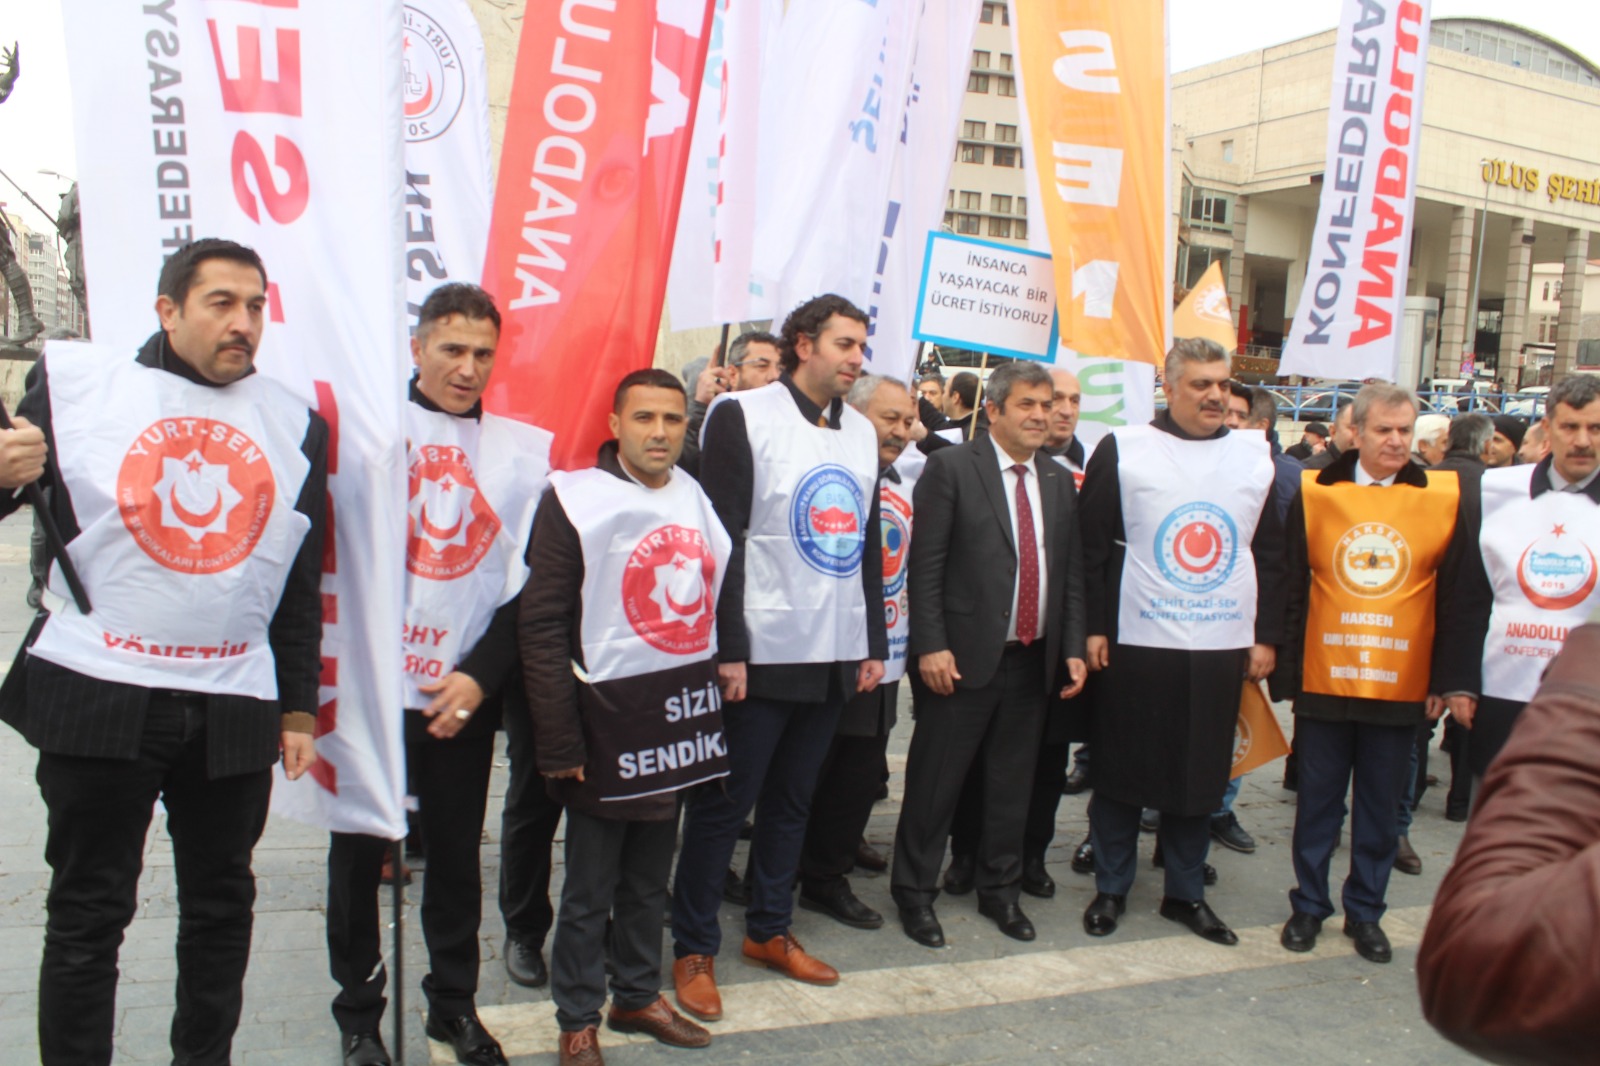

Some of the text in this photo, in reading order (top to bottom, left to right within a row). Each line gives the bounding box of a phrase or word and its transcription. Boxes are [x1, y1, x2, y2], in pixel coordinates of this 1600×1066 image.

[1480, 158, 1540, 193] ULUS
[966, 250, 1028, 276] İNSANCA
[938, 271, 1048, 303] YAŞAYACAK BİR
[930, 289, 1049, 326] ÜCRET İSTİYORUZ
[129, 419, 263, 465] YURT-SEN
[1341, 612, 1393, 628] HAKSEN
[1504, 644, 1561, 659] KONFEDER
